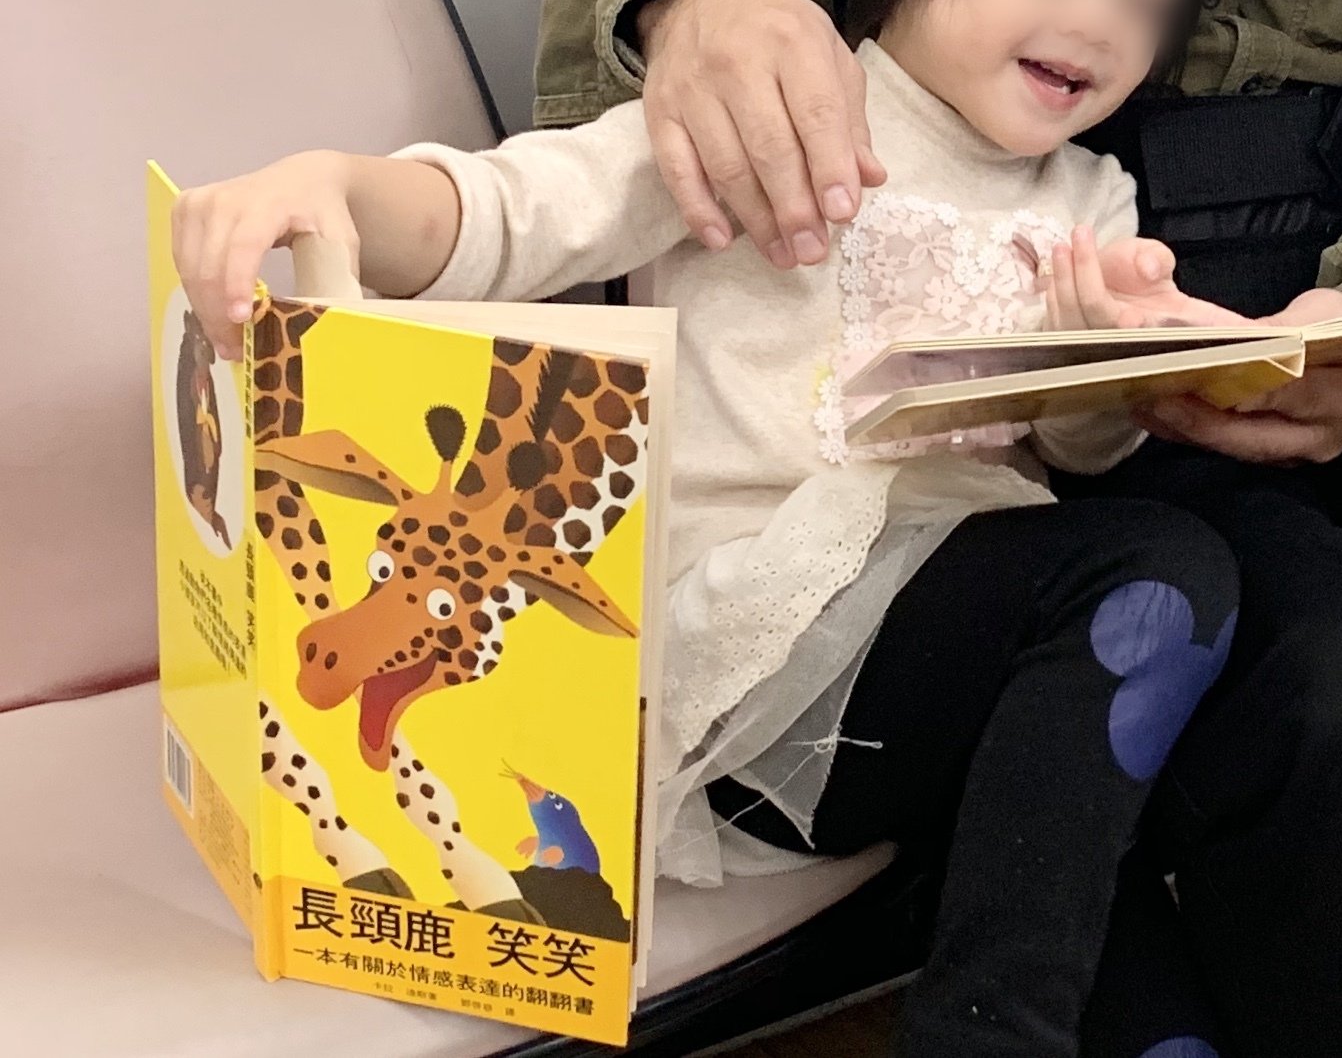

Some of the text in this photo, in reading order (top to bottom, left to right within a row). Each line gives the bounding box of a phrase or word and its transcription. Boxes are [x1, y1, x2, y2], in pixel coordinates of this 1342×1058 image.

[292, 887, 596, 986] 長頸鹿 笑笑
[293, 947, 595, 1015] 一本有關於情感表達的翻翻書
